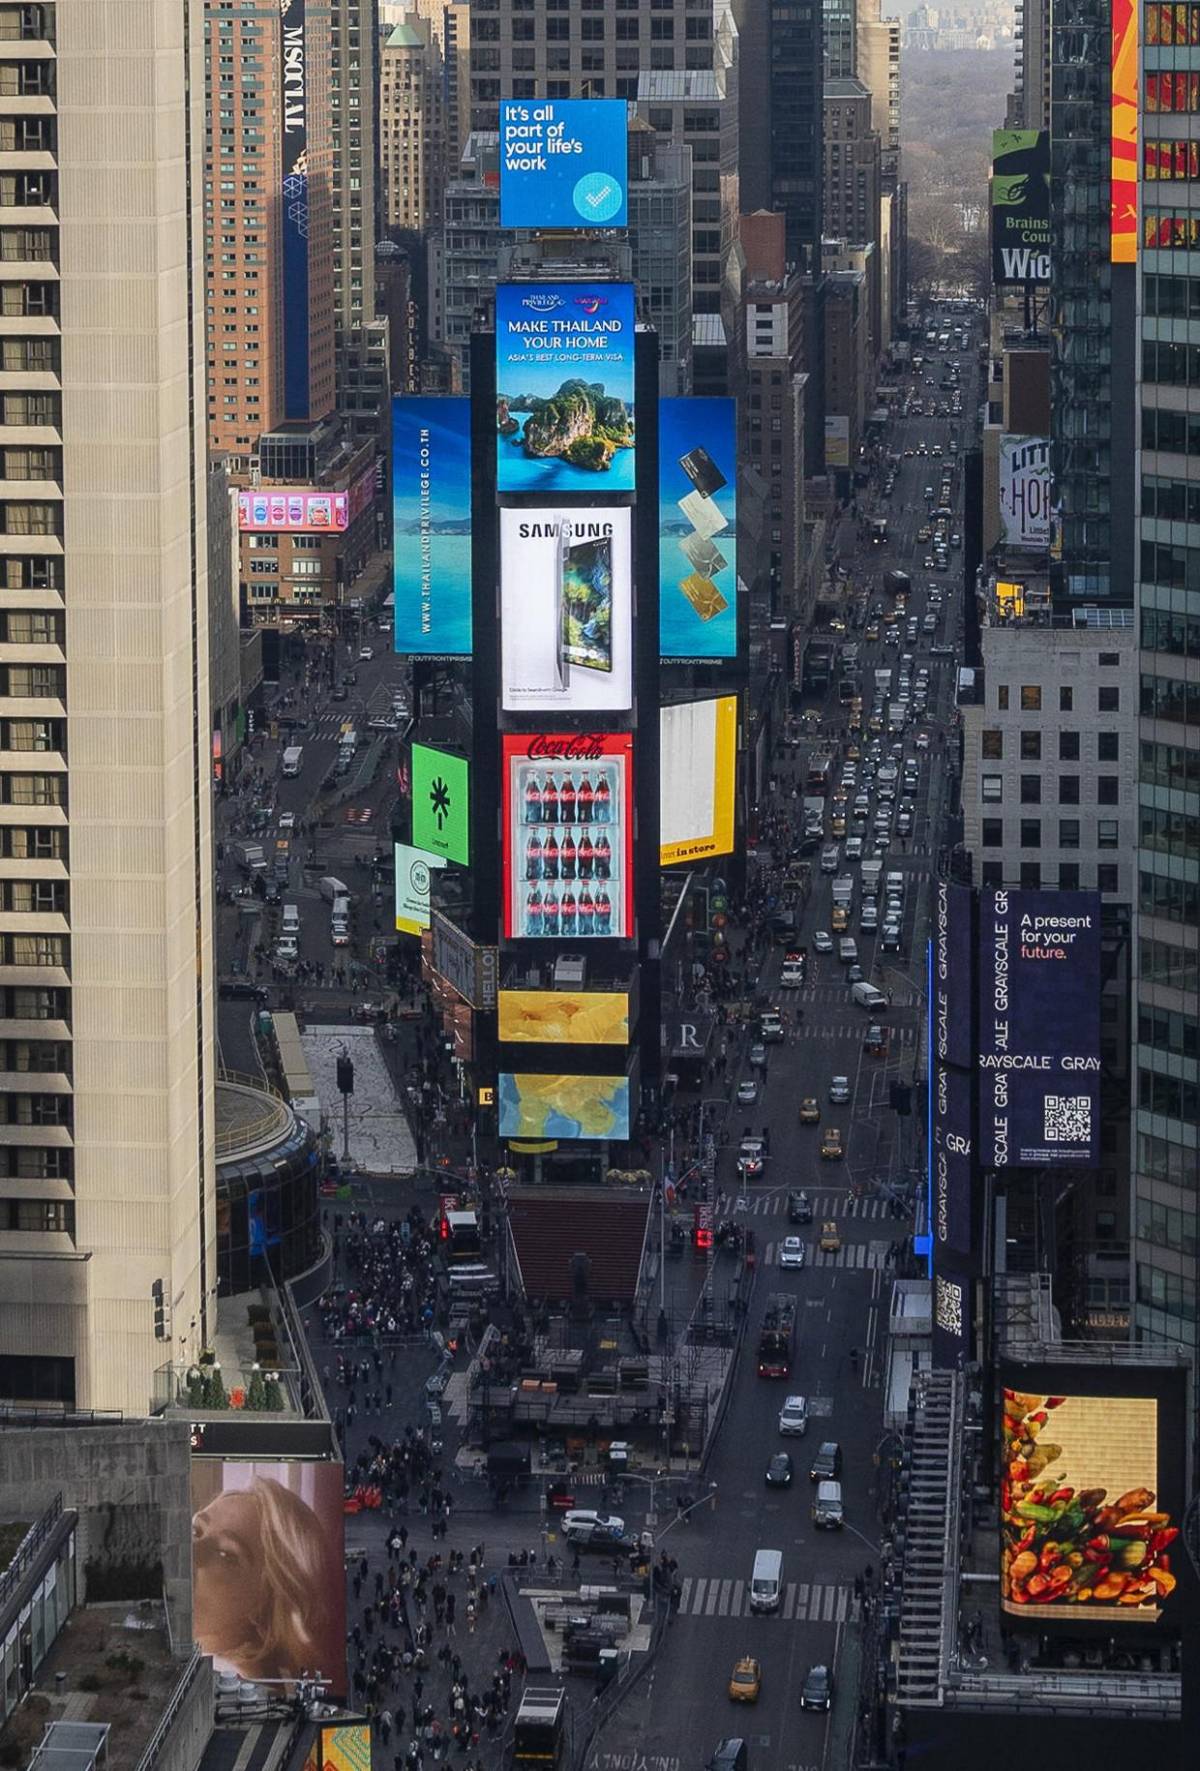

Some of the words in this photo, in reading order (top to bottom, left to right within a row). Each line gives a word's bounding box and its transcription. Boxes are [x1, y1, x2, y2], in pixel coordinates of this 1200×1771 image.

[505, 105, 529, 121] It's
[533, 105, 553, 121] all
[505, 124, 543, 140] part
[547, 122, 565, 137] of
[505, 141, 543, 157] your
[547, 138, 582, 153] life's
[505, 156, 546, 170] work
[508, 320, 548, 333] MAKE
[551, 320, 621, 332] THAILAND
[523, 336, 562, 348] YOUR
[566, 336, 608, 348] HOME
[519, 523, 613, 537] SAMSUNG
[677, 847, 688, 857] in
[689, 844, 716, 855] store
[995, 890, 1008, 914] GR
[1021, 914, 1032, 927] A
[1034, 914, 1091, 930] present
[1021, 929, 1042, 943] for
[1044, 932, 1077, 947] your
[1021, 945, 1067, 959] future.
[995, 922, 1008, 1011] GRAYSCALE
[680, 1023, 703, 1048] R
[1061, 1056, 1101, 1070] GRAY
[995, 1117, 1008, 1166] SCALE
